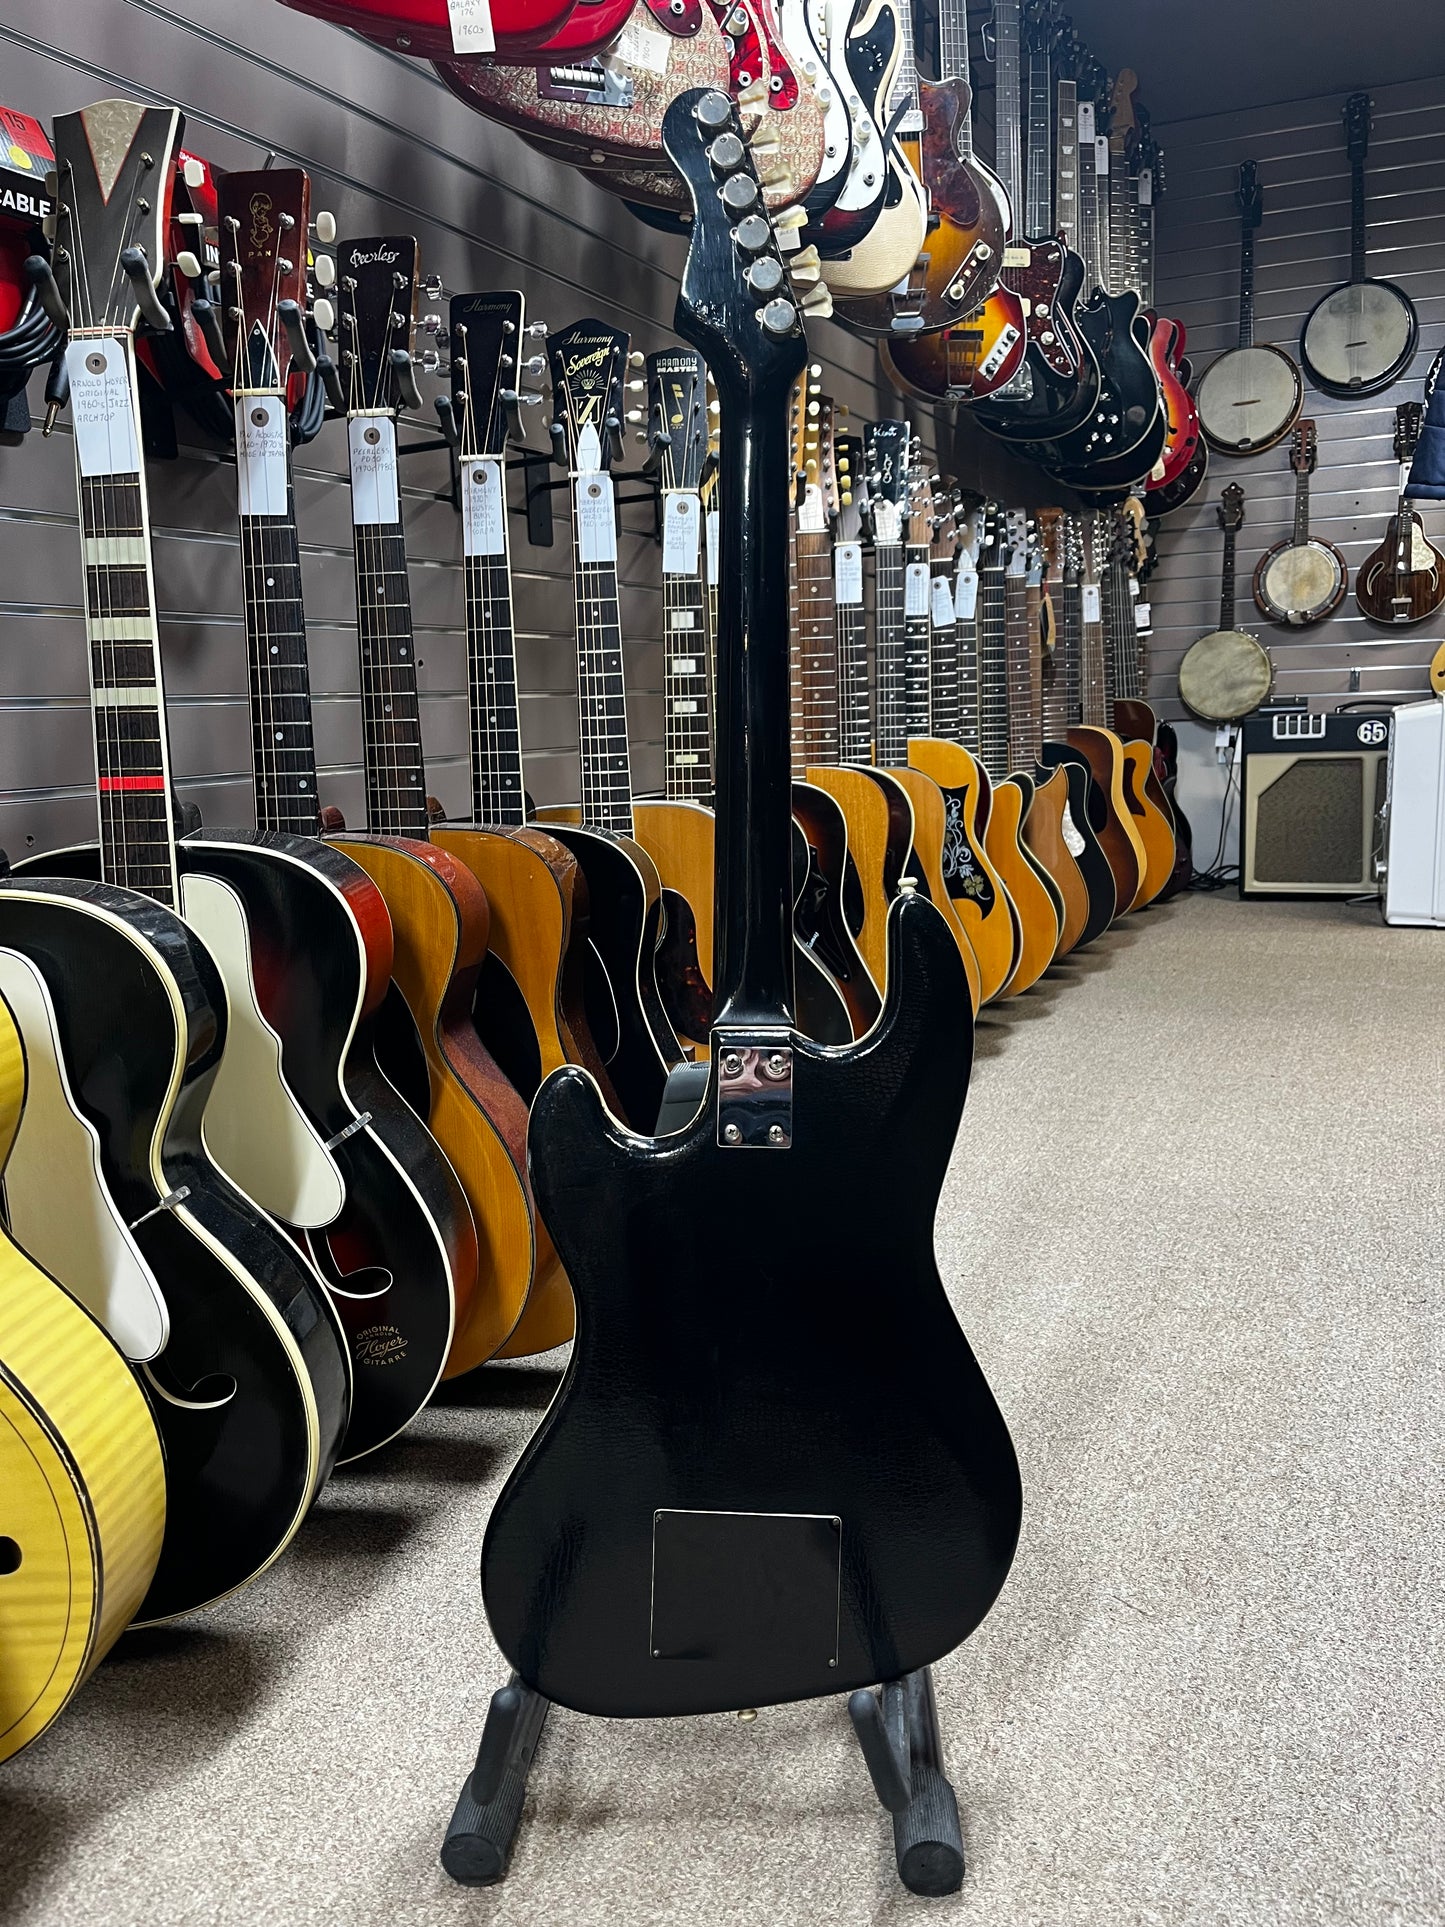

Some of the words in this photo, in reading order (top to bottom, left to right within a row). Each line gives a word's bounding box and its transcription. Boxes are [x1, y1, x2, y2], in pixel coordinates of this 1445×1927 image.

[5, 112, 26, 131] 15
[0, 188, 51, 218] ABLE
[248, 250, 271, 258] PAN
[350, 243, 400, 268] Peerless
[462, 298, 513, 313] Harmony
[561, 331, 614, 346] Harmony
[566, 346, 610, 376] Sovereign
[656, 357, 697, 367] HARMONY
[108, 398, 129, 408] JAZZ
[1359, 722, 1385, 743] 65
[356, 1326, 400, 1339] ORIGINAL
[355, 1336, 408, 1360] Hoyer
[363, 1350, 407, 1366] GITARRE
